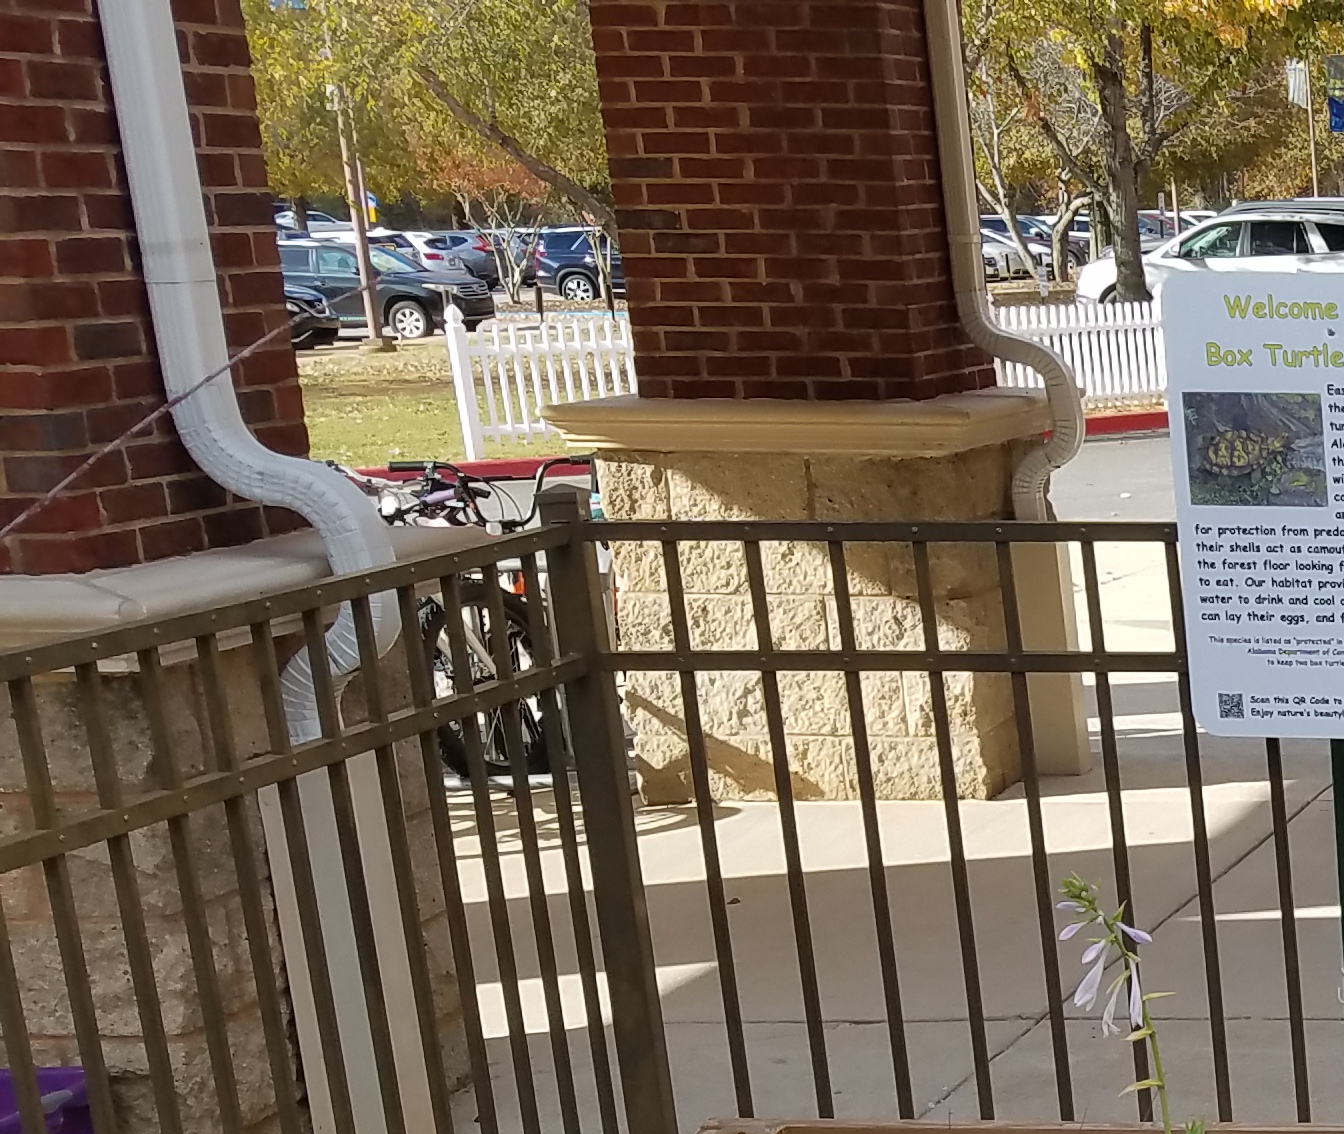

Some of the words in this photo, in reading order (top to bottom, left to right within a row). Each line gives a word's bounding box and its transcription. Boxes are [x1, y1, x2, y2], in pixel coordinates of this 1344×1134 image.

[1223, 293, 1338, 320] Welcome
[1205, 341, 1252, 366] Box
[1263, 343, 1344, 368] Turtle
[1195, 523, 1213, 535] for
[1217, 524, 1277, 539] protection
[1281, 525, 1309, 537] from
[1196, 541, 1224, 552] their
[1229, 541, 1261, 553] shells
[1266, 543, 1284, 553] act
[1289, 545, 1302, 554] as
[1197, 558, 1217, 570] the
[1222, 558, 1258, 571] forest
[1263, 559, 1291, 571] floor
[1295, 560, 1334, 574] looking
[1198, 577, 1211, 587] to
[1216, 577, 1239, 587] eat.
[1245, 577, 1266, 587] Our
[1271, 577, 1313, 589] habitat
[1199, 594, 1233, 604] water
[1238, 595, 1250, 604] to
[1254, 594, 1284, 605] drink
[1288, 595, 1309, 605] and
[1313, 595, 1335, 606] cool
[1201, 613, 1221, 621] can
[1225, 610, 1242, 625] lay
[1247, 611, 1275, 622] their
[1280, 614, 1310, 626] eggs,
[1315, 612, 1335, 623] and
[1250, 695, 1271, 704] Scan
[1273, 696, 1290, 704] this
[1292, 696, 1307, 706] QR
[1309, 696, 1330, 705] Code
[1250, 707, 1274, 719] Enjoy
[1277, 708, 1311, 717] nature's
[1314, 709, 1344, 720] beauty!
